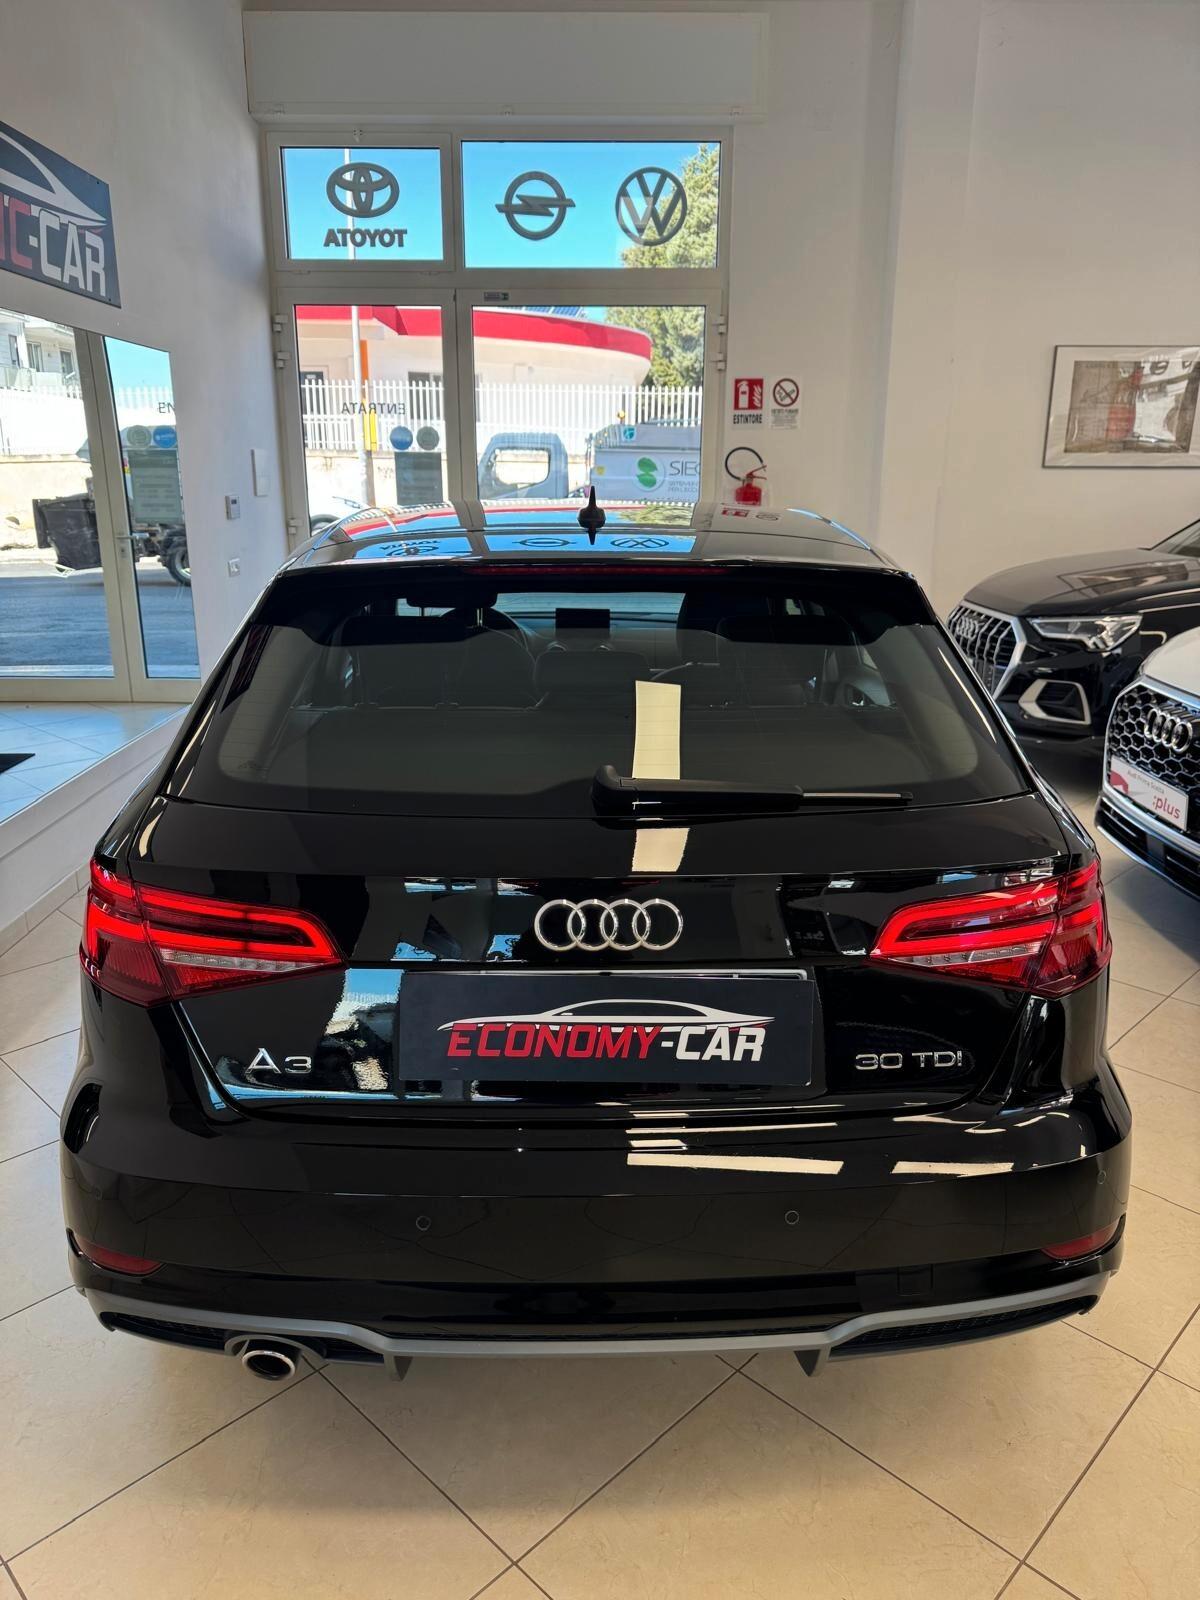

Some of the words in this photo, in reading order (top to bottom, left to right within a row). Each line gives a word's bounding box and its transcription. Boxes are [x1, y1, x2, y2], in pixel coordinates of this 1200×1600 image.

[733, 414, 763, 424] ESTINTORE
[447, 1024, 765, 1062] ECONOMY-CAR
[245, 1048, 312, 1074] A3
[855, 1053, 903, 1070] 30
